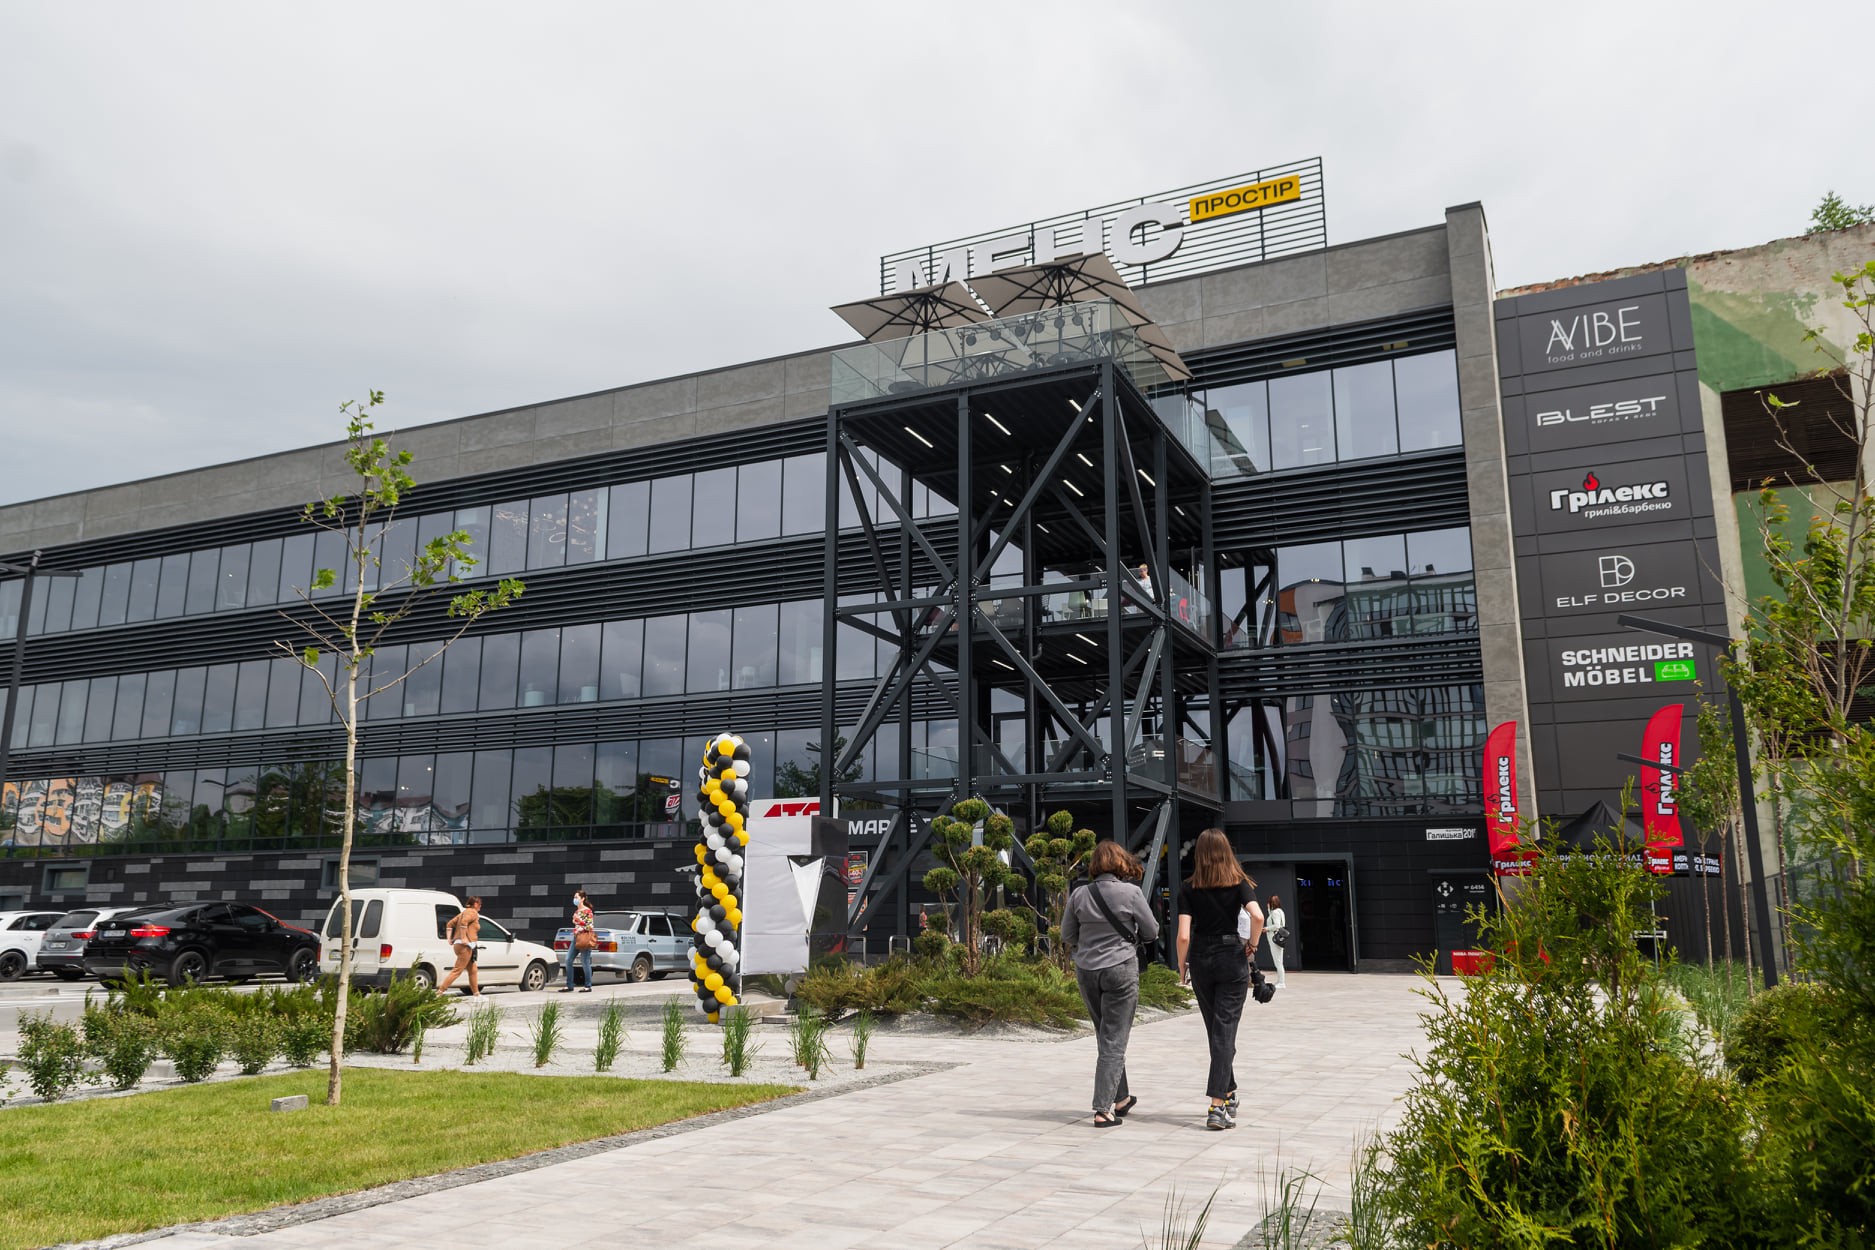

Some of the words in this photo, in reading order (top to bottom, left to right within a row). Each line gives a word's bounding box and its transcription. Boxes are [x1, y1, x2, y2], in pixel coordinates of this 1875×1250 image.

[1195, 181, 1294, 215] ПРОСТІР
[1548, 353, 1575, 364] food
[1580, 348, 1603, 359] and
[1608, 343, 1642, 354] drinks
[1537, 396, 1667, 426] BLEST
[1550, 477, 1668, 513] Грілекс
[1584, 501, 1672, 519] грилі&барбекю
[1556, 595, 1598, 608] ELF
[1604, 586, 1686, 604] DECOR
[1561, 642, 1694, 666] SCHNEIDER
[1564, 665, 1653, 687] MÖBEL
